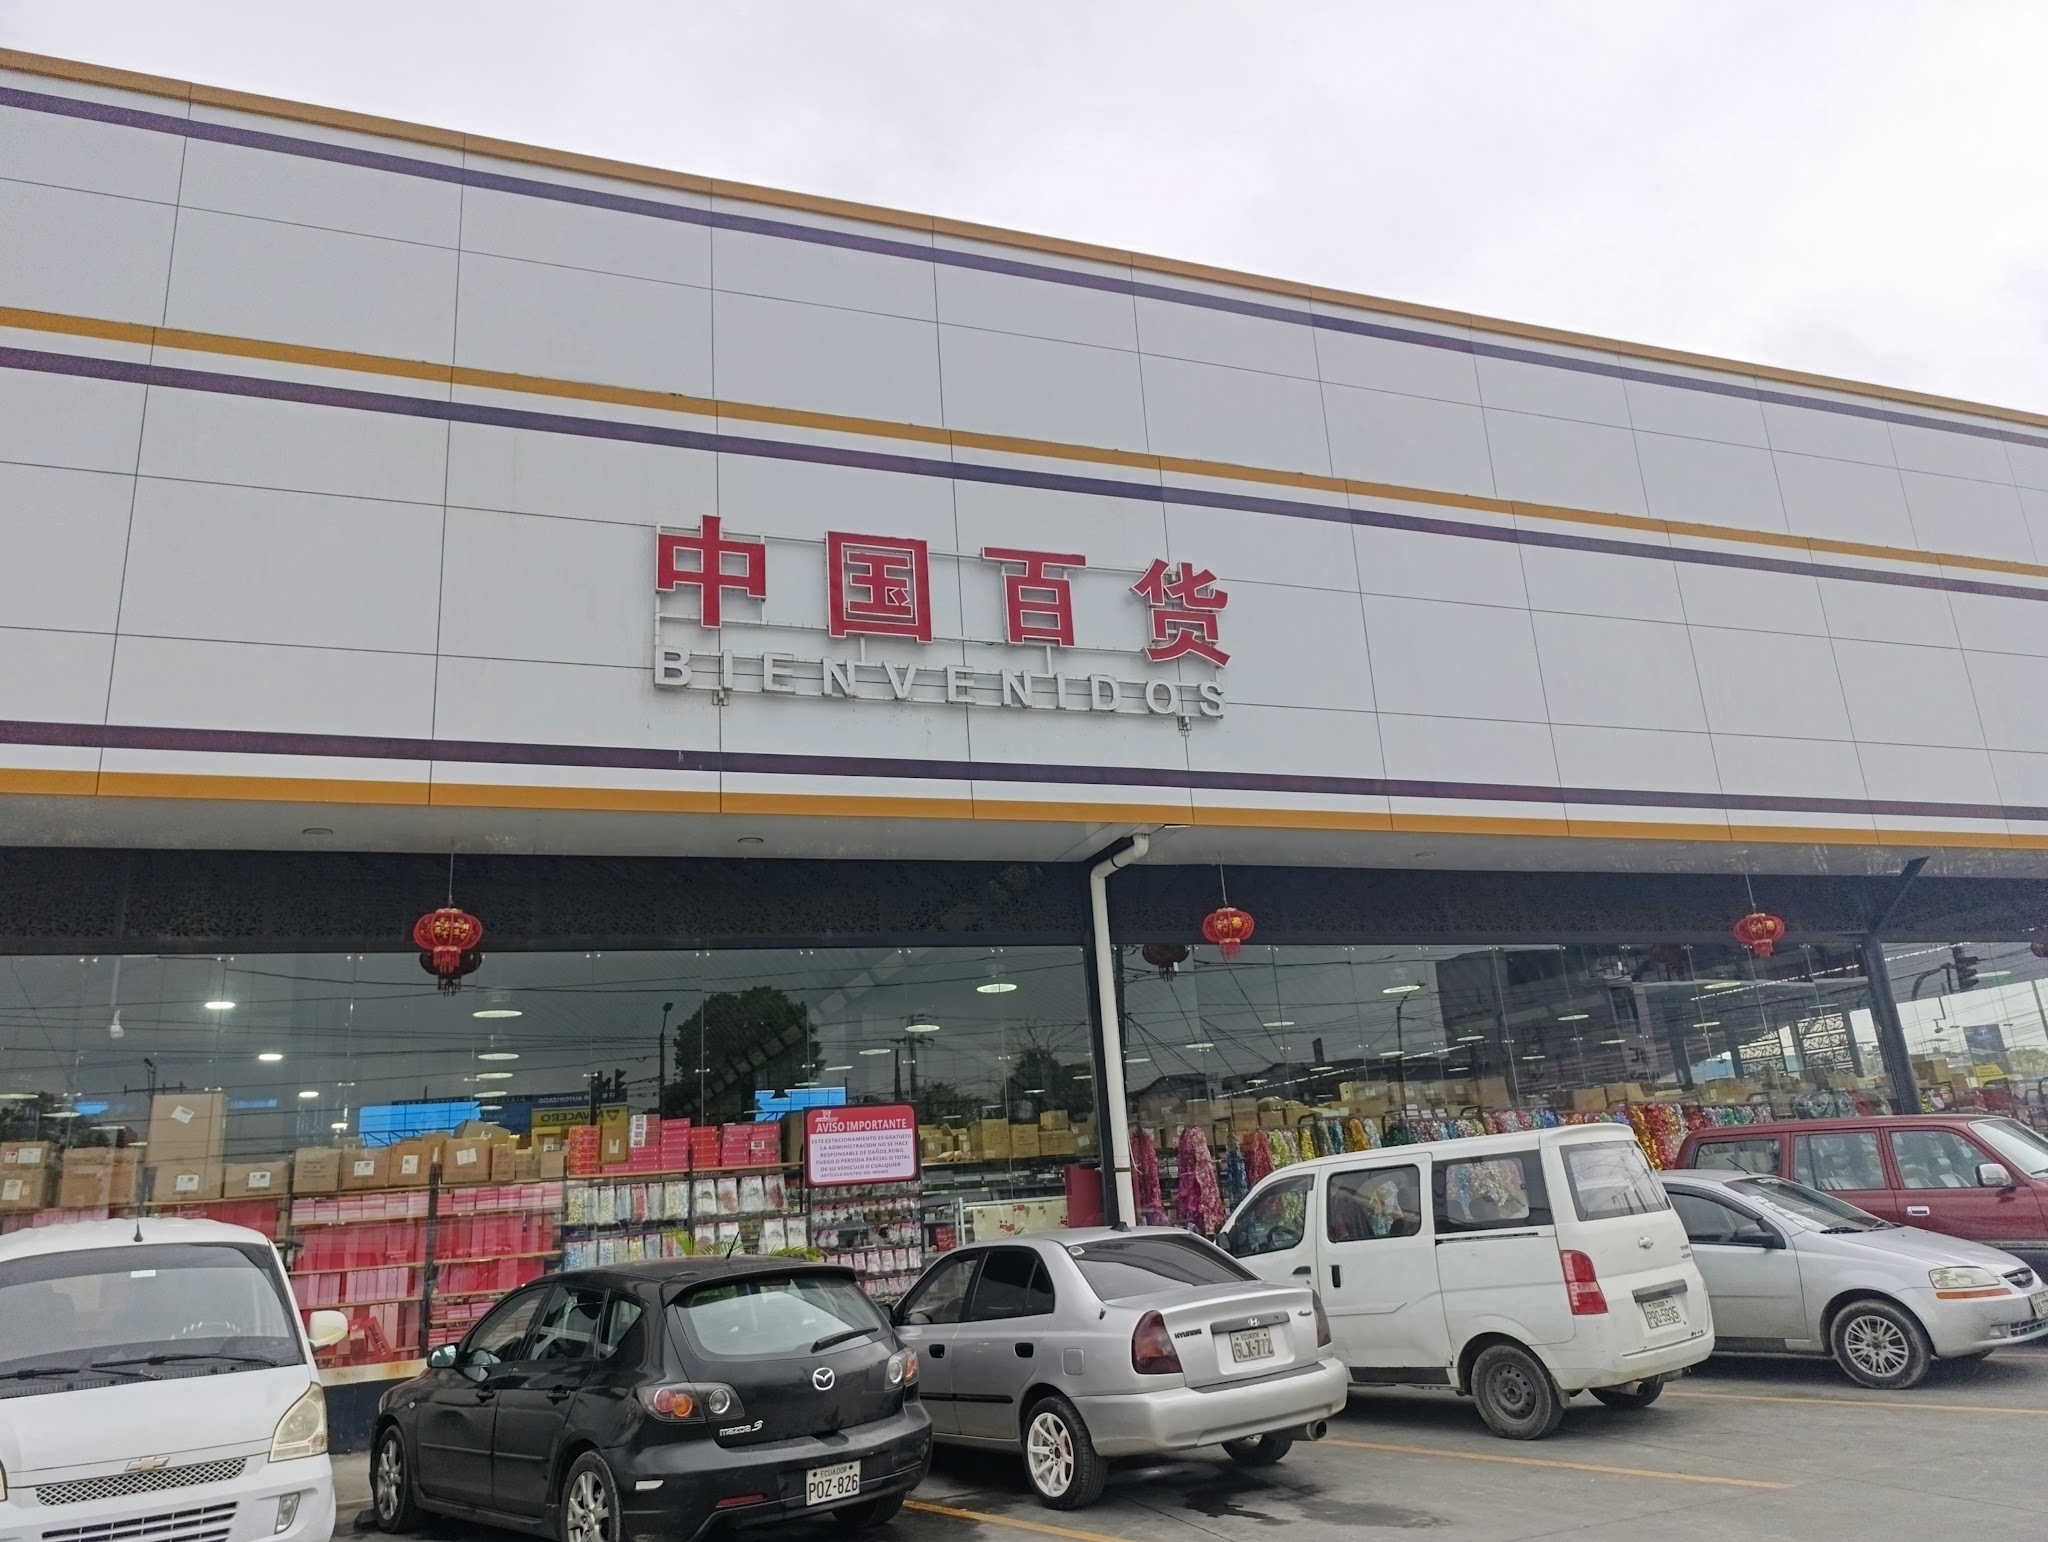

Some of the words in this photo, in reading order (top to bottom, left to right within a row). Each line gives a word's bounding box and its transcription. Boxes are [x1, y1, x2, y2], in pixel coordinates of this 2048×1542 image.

[656, 514, 1231, 668] 中国百货
[654, 646, 1227, 717] BIENVENIDOS
[815, 1121, 845, 1133] AVISO
[846, 1118, 907, 1131] IMPORTANTE
[825, 1135, 877, 1144] ESTACIONAMIENTO
[828, 1142, 877, 1150] ADMINISTRACION
[820, 1466, 848, 1478] ECUADOR
[808, 1473, 858, 1501] POZ-826
